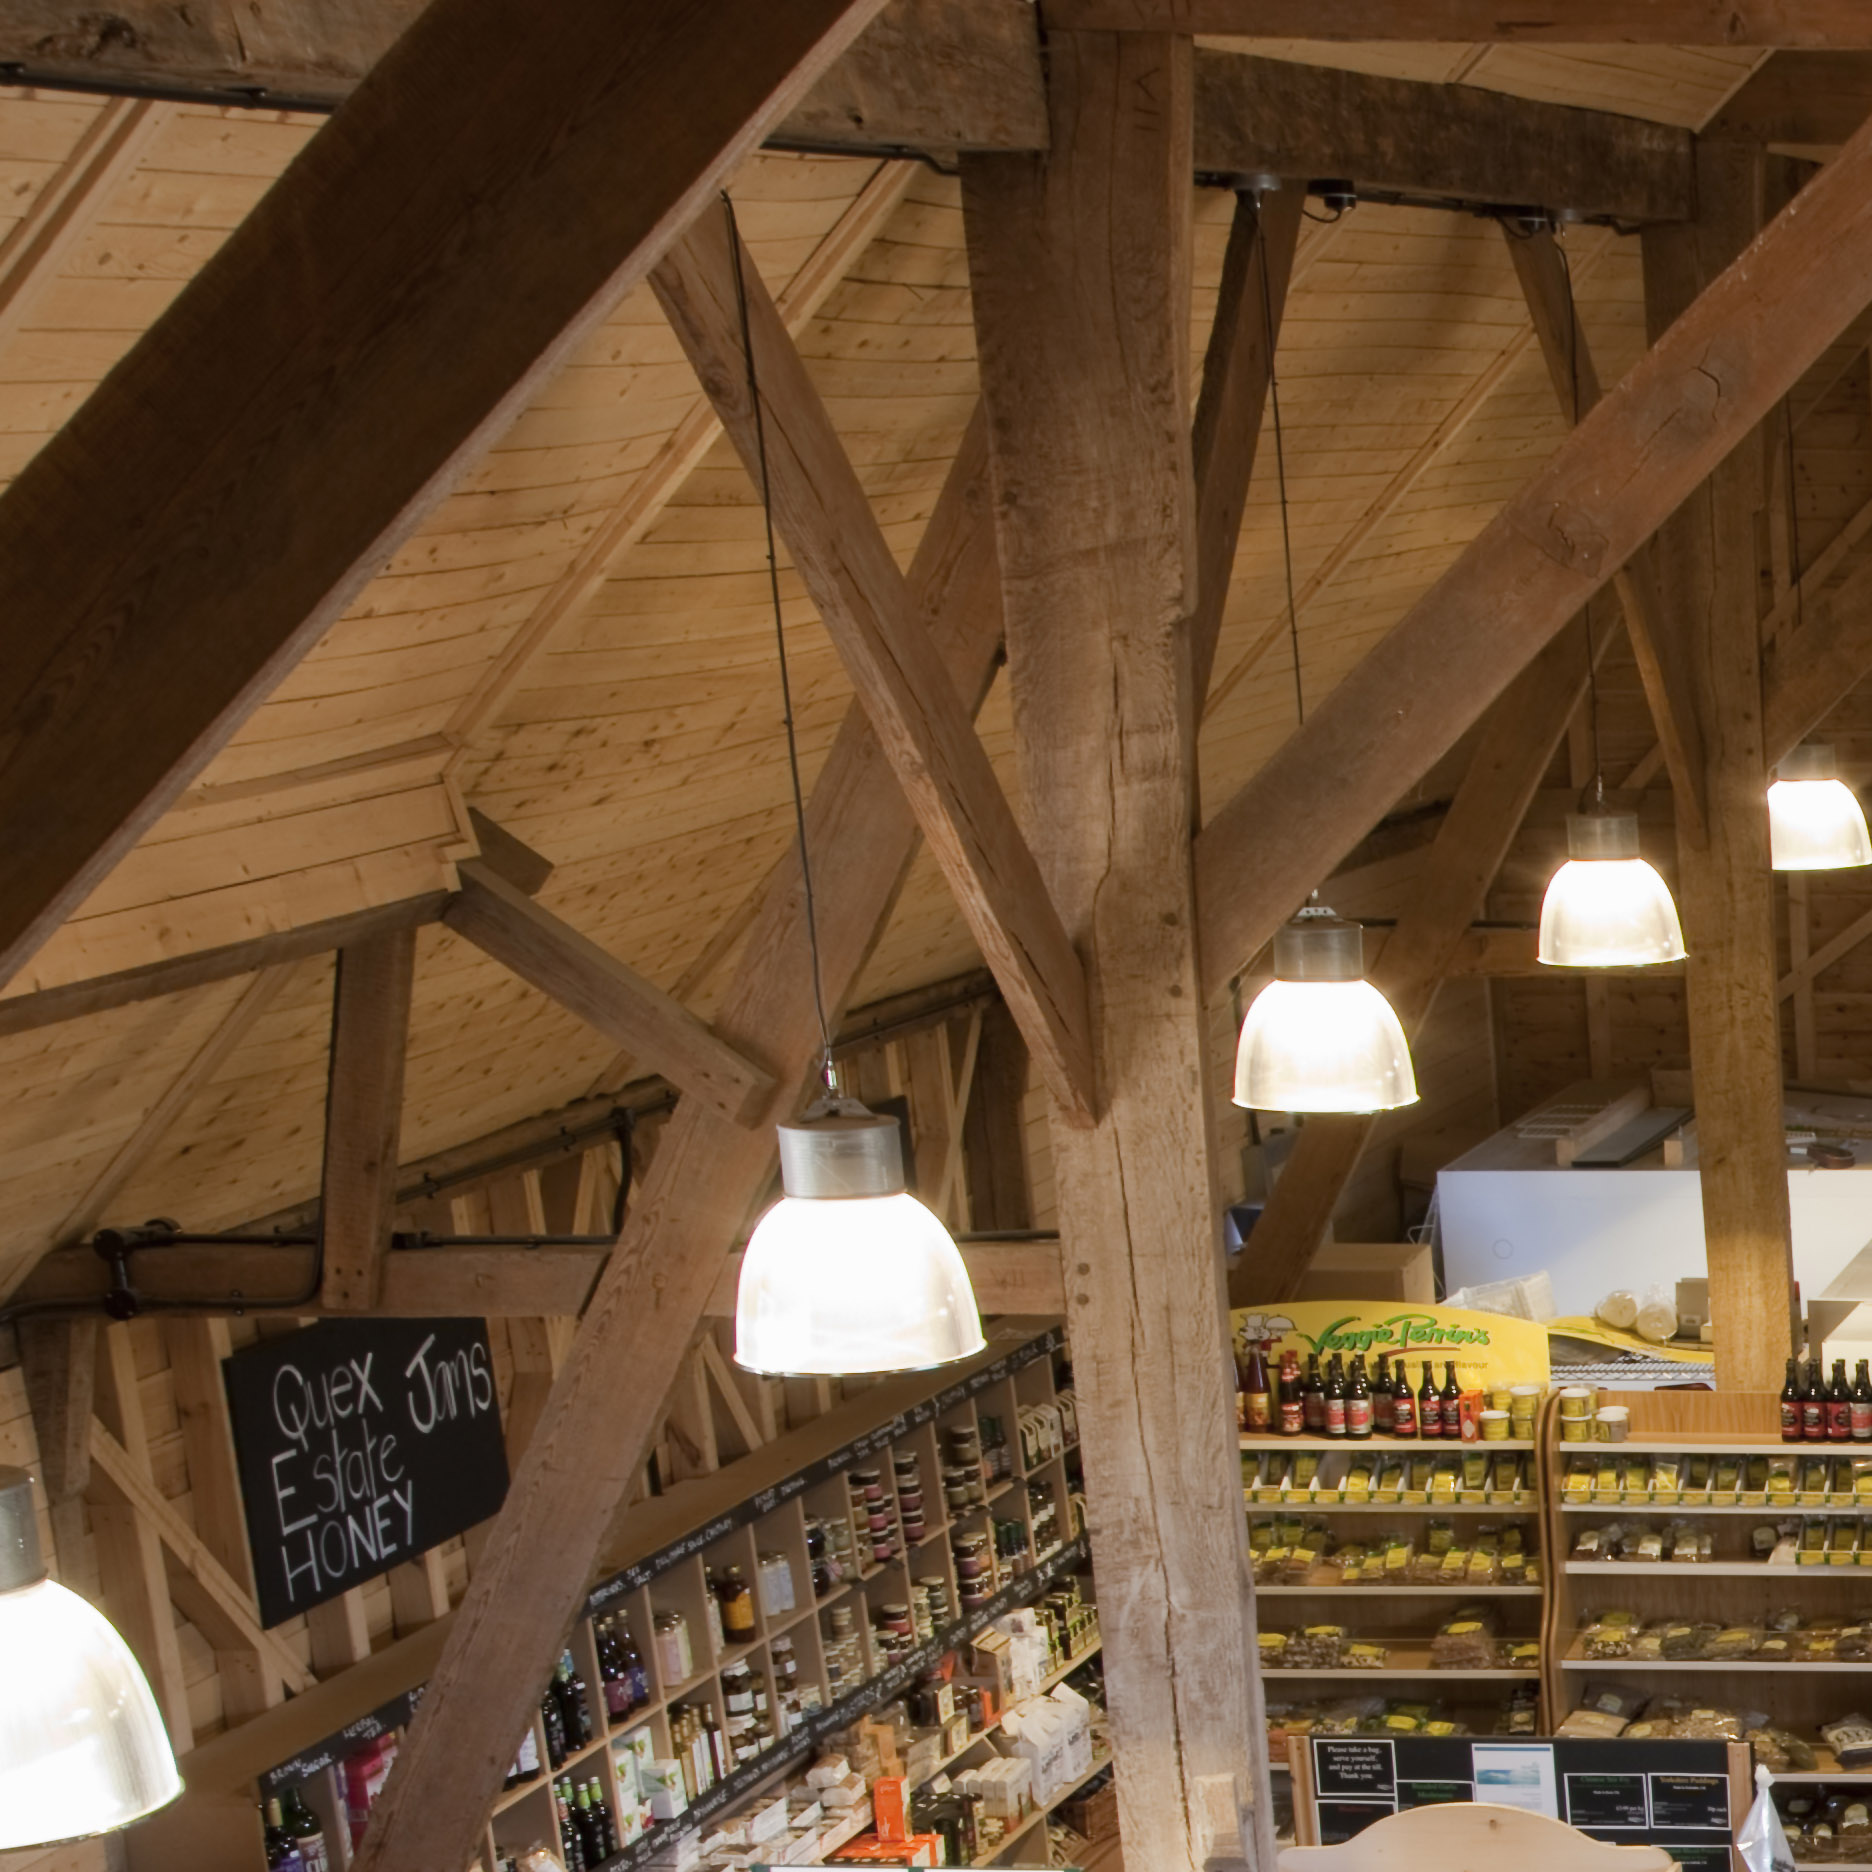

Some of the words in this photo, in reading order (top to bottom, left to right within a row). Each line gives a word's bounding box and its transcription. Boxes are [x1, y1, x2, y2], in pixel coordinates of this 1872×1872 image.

[273, 1352, 383, 1452] Quex
[405, 1333, 492, 1433] Jams
[1297, 1316, 1398, 1355] Veggie
[271, 1418, 405, 1536] Estate
[280, 1479, 413, 1601] HONEY
